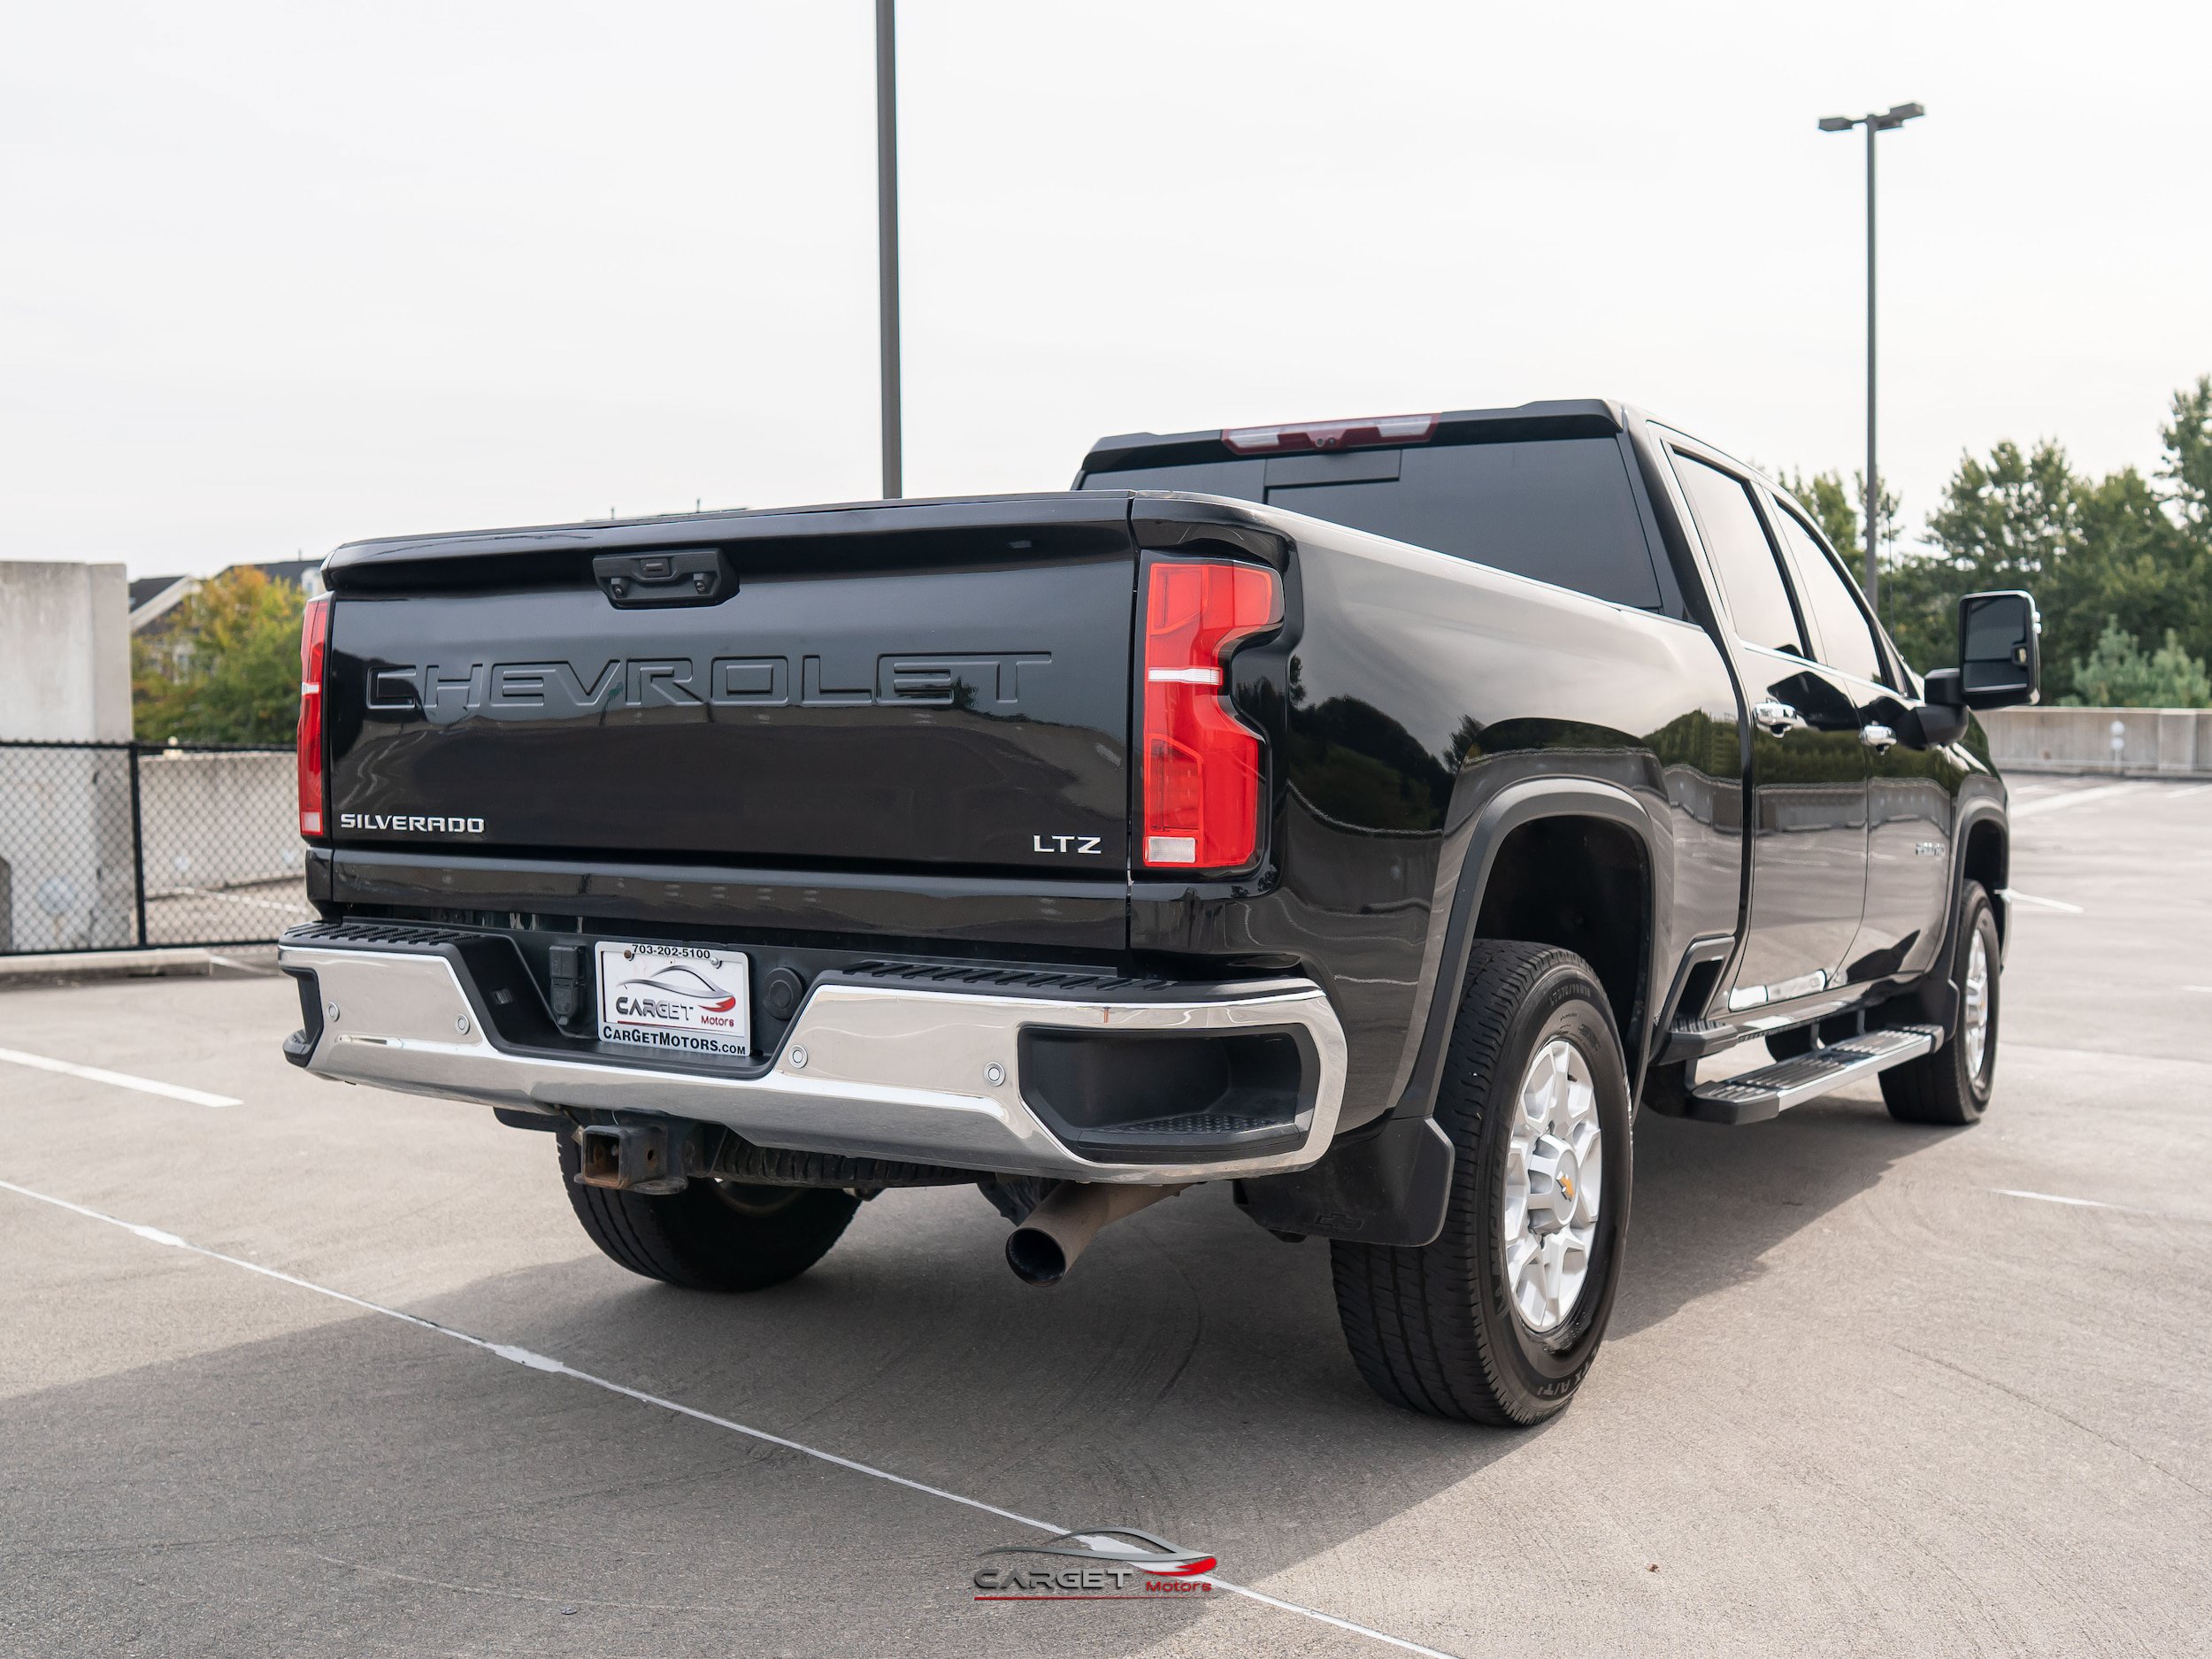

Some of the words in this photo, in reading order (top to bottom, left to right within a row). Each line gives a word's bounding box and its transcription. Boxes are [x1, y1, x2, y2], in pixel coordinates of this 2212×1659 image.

[366, 650, 1052, 709] CHEVROLET
[341, 813, 485, 833] SILVERADO
[1033, 835, 1102, 855] LTZ
[632, 944, 710, 959] 703-202-5100
[616, 996, 694, 1021] CARGET
[701, 1015, 734, 1027] Motors
